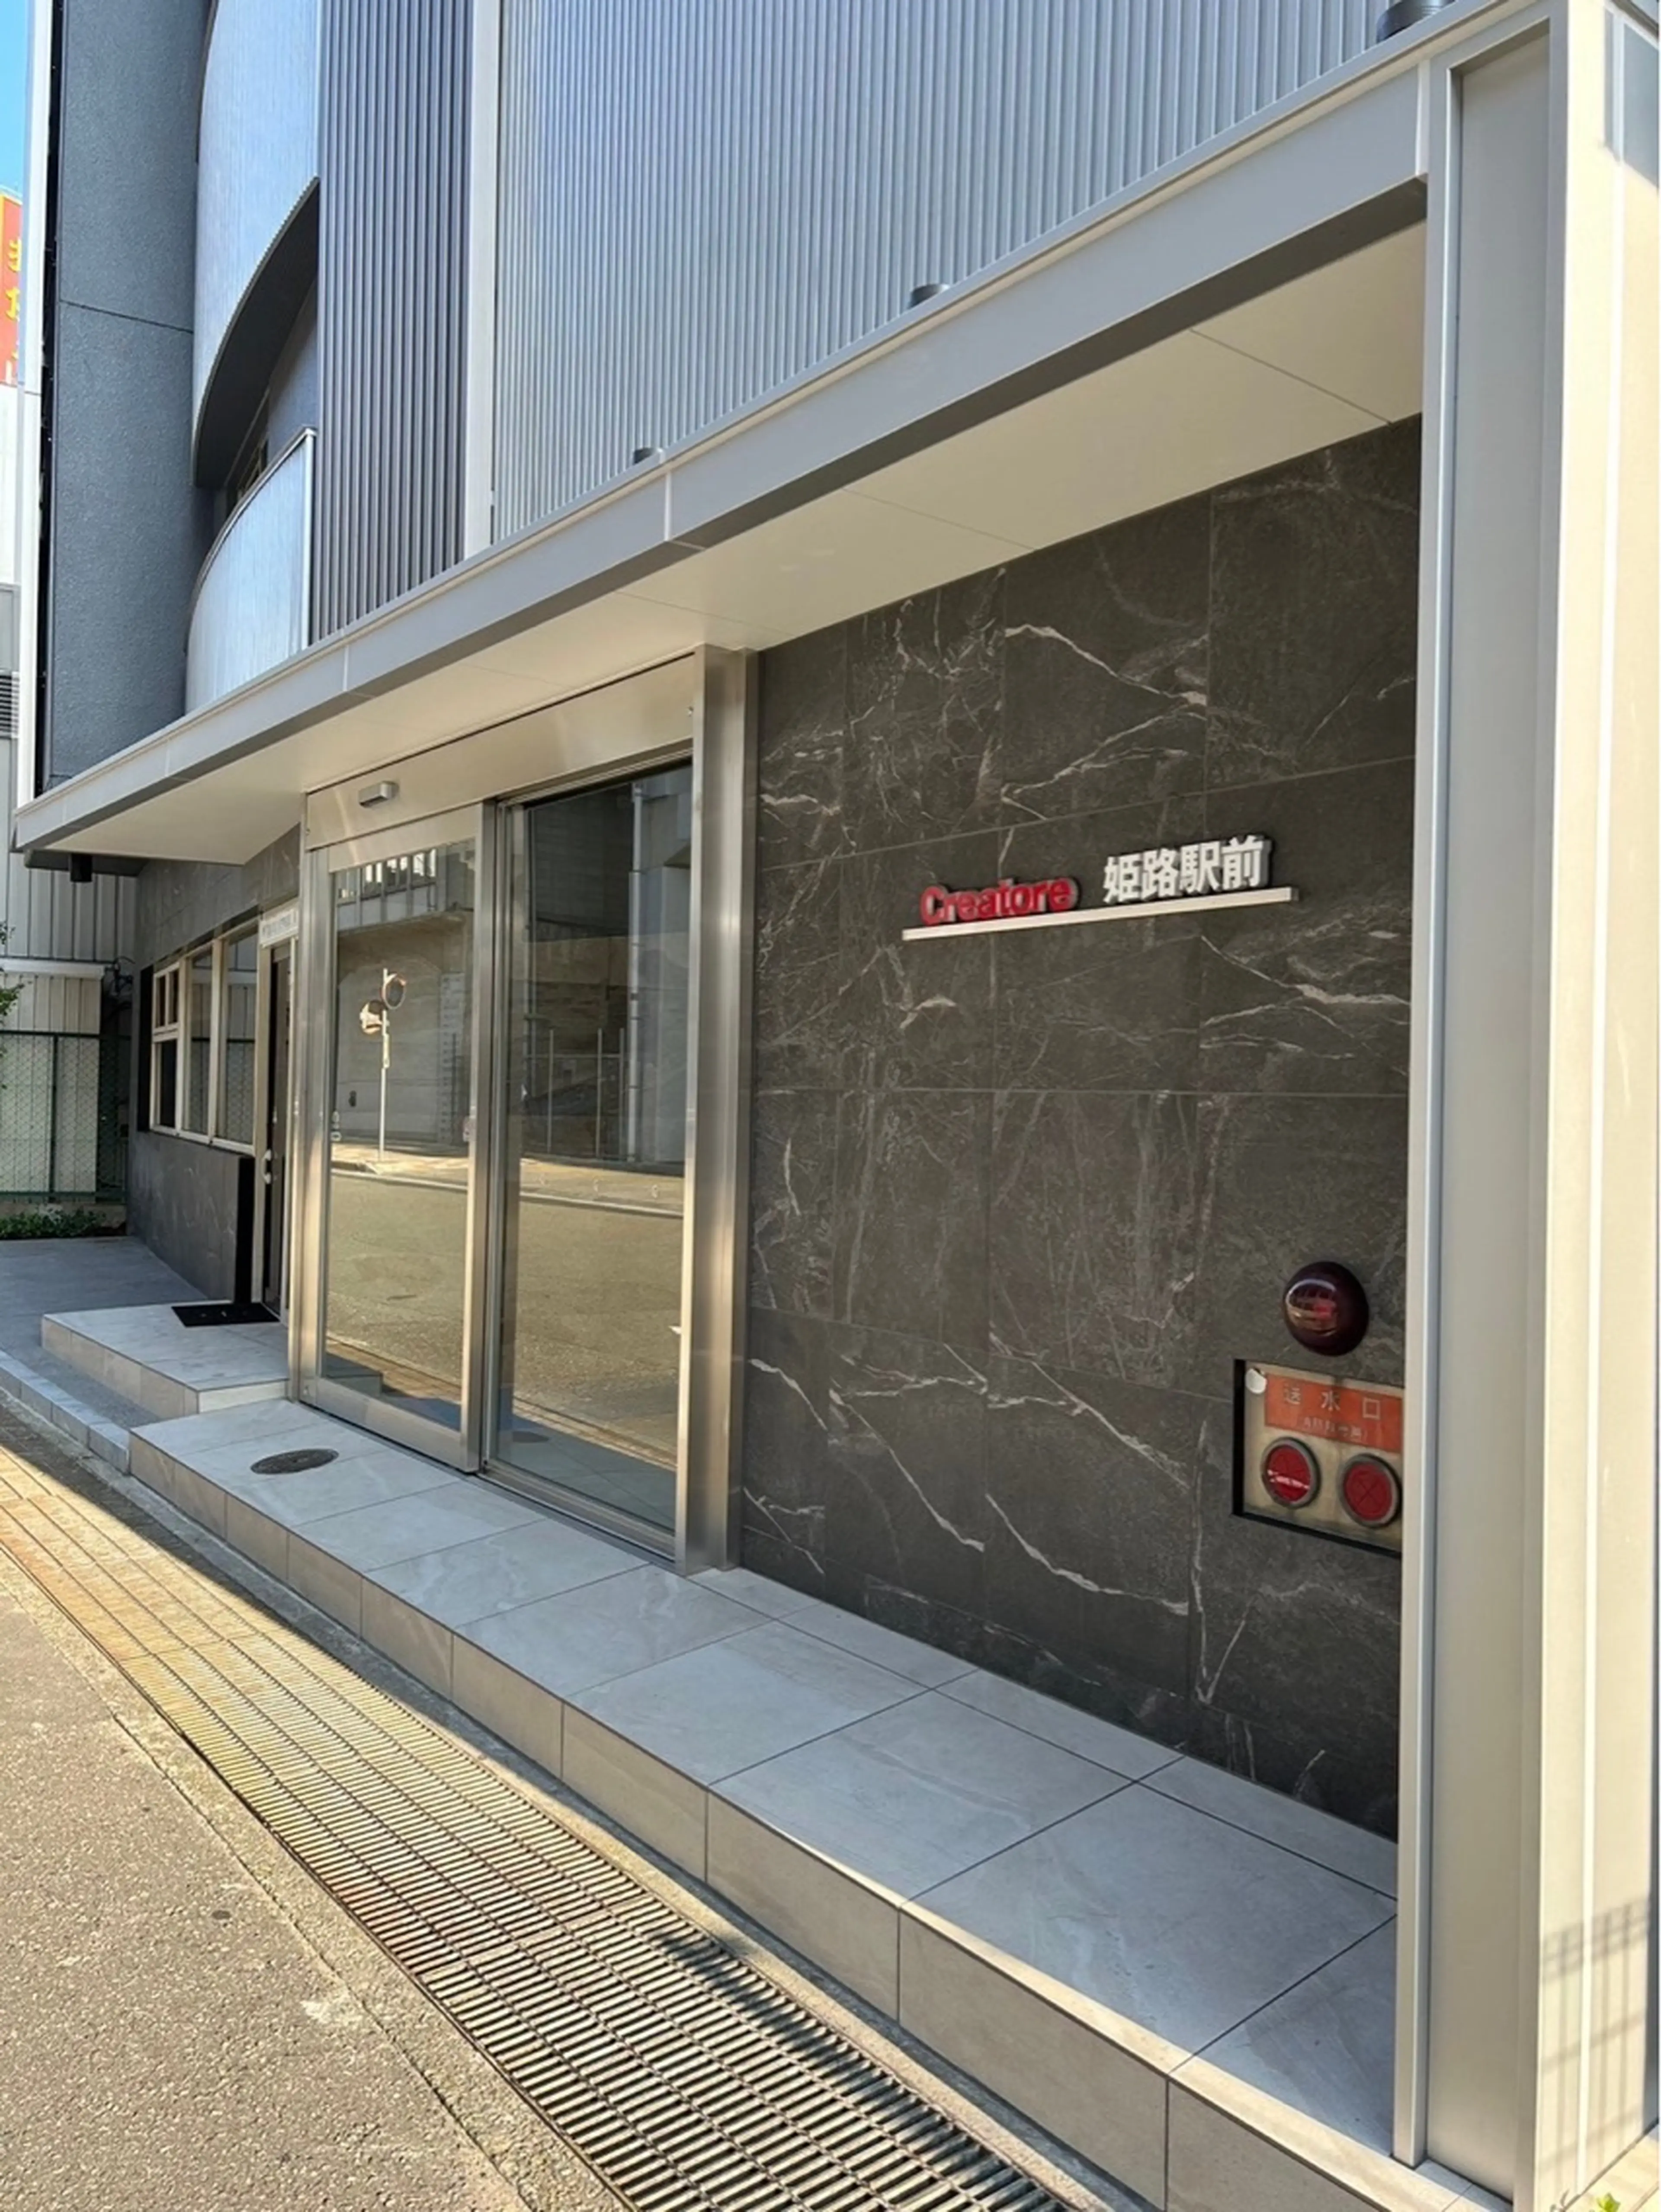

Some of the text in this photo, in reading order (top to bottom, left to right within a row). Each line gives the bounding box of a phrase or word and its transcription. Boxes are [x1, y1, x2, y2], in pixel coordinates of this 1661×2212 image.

[920, 835, 1268, 926] Creatore 姫路駅前
